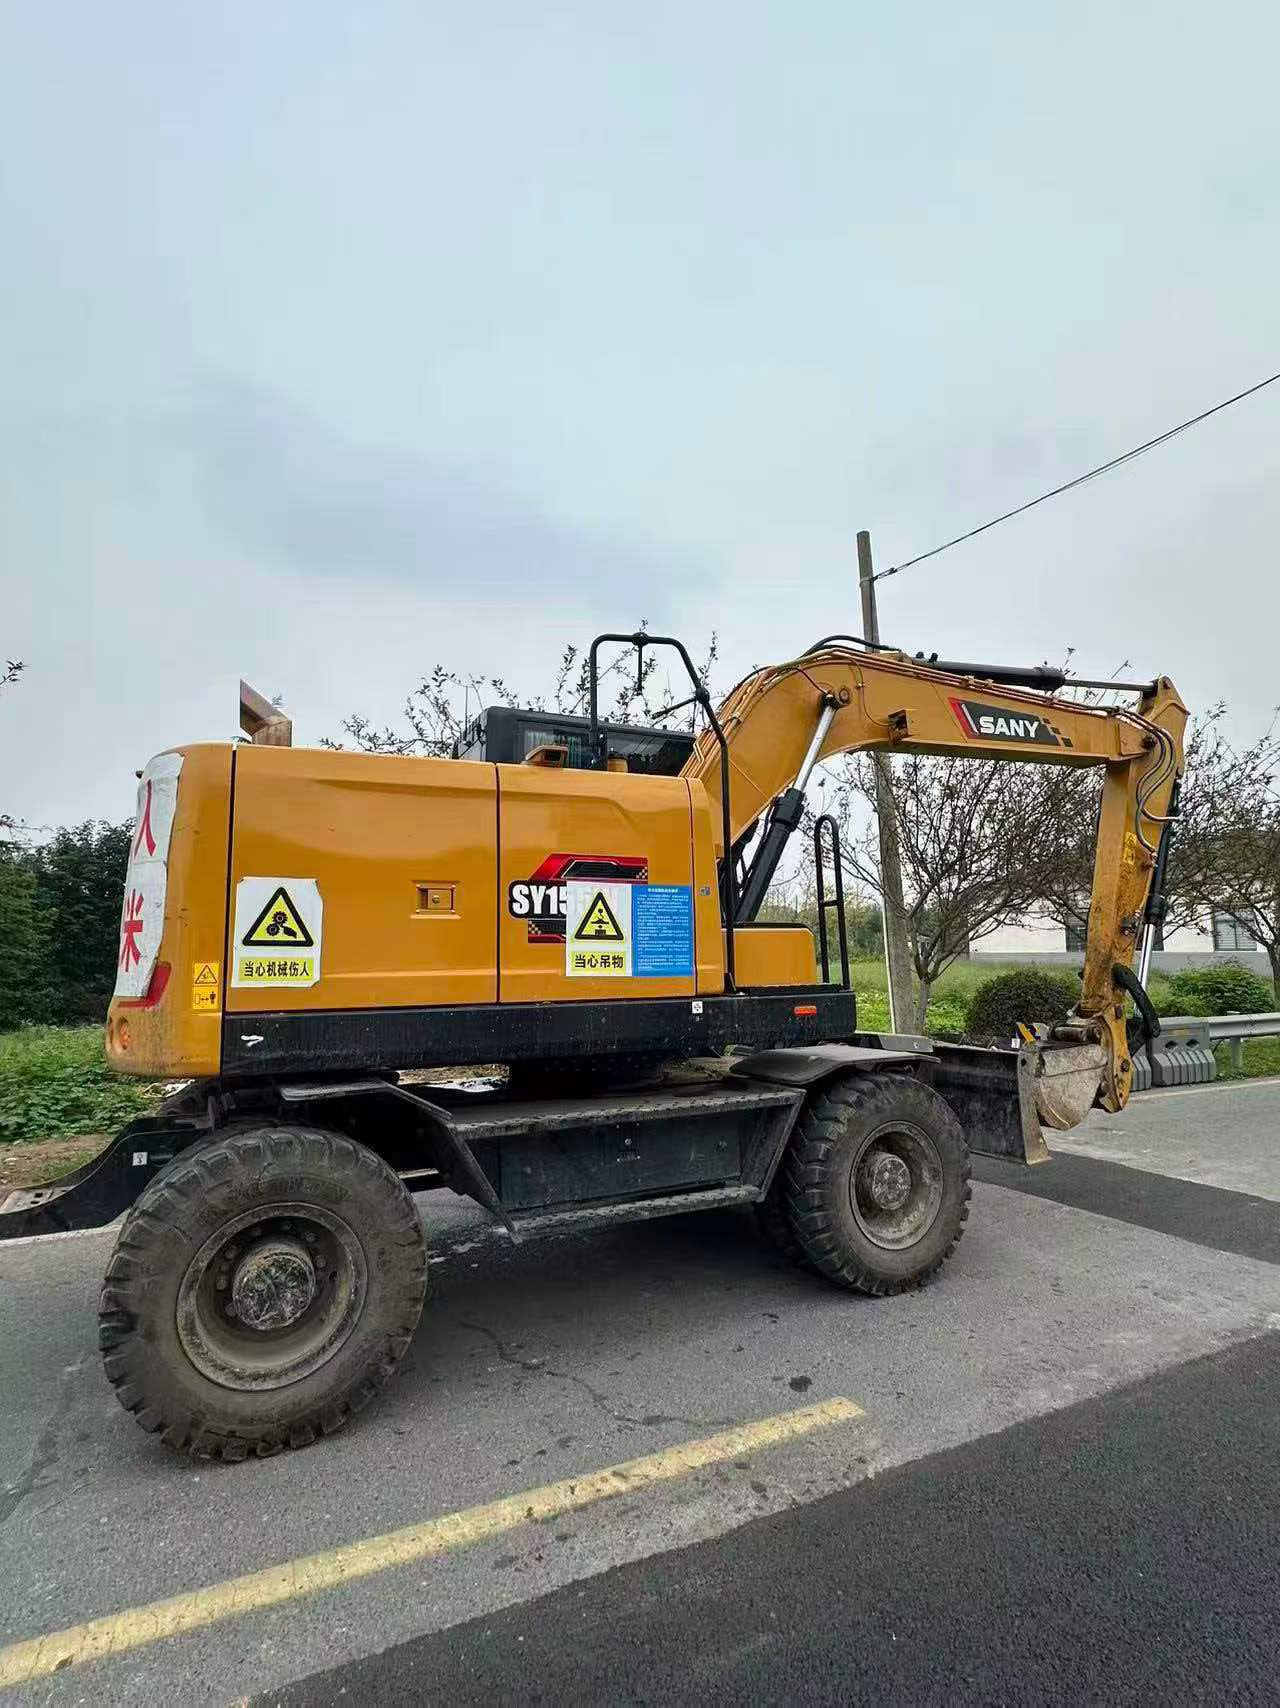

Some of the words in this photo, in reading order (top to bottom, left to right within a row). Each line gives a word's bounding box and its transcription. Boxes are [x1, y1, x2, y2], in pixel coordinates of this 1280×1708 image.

[979, 716, 1040, 738] SANY
[133, 778, 157, 859] 人
[243, 960, 310, 978] 当心机械伤人
[574, 954, 624, 969] 当心吊物
